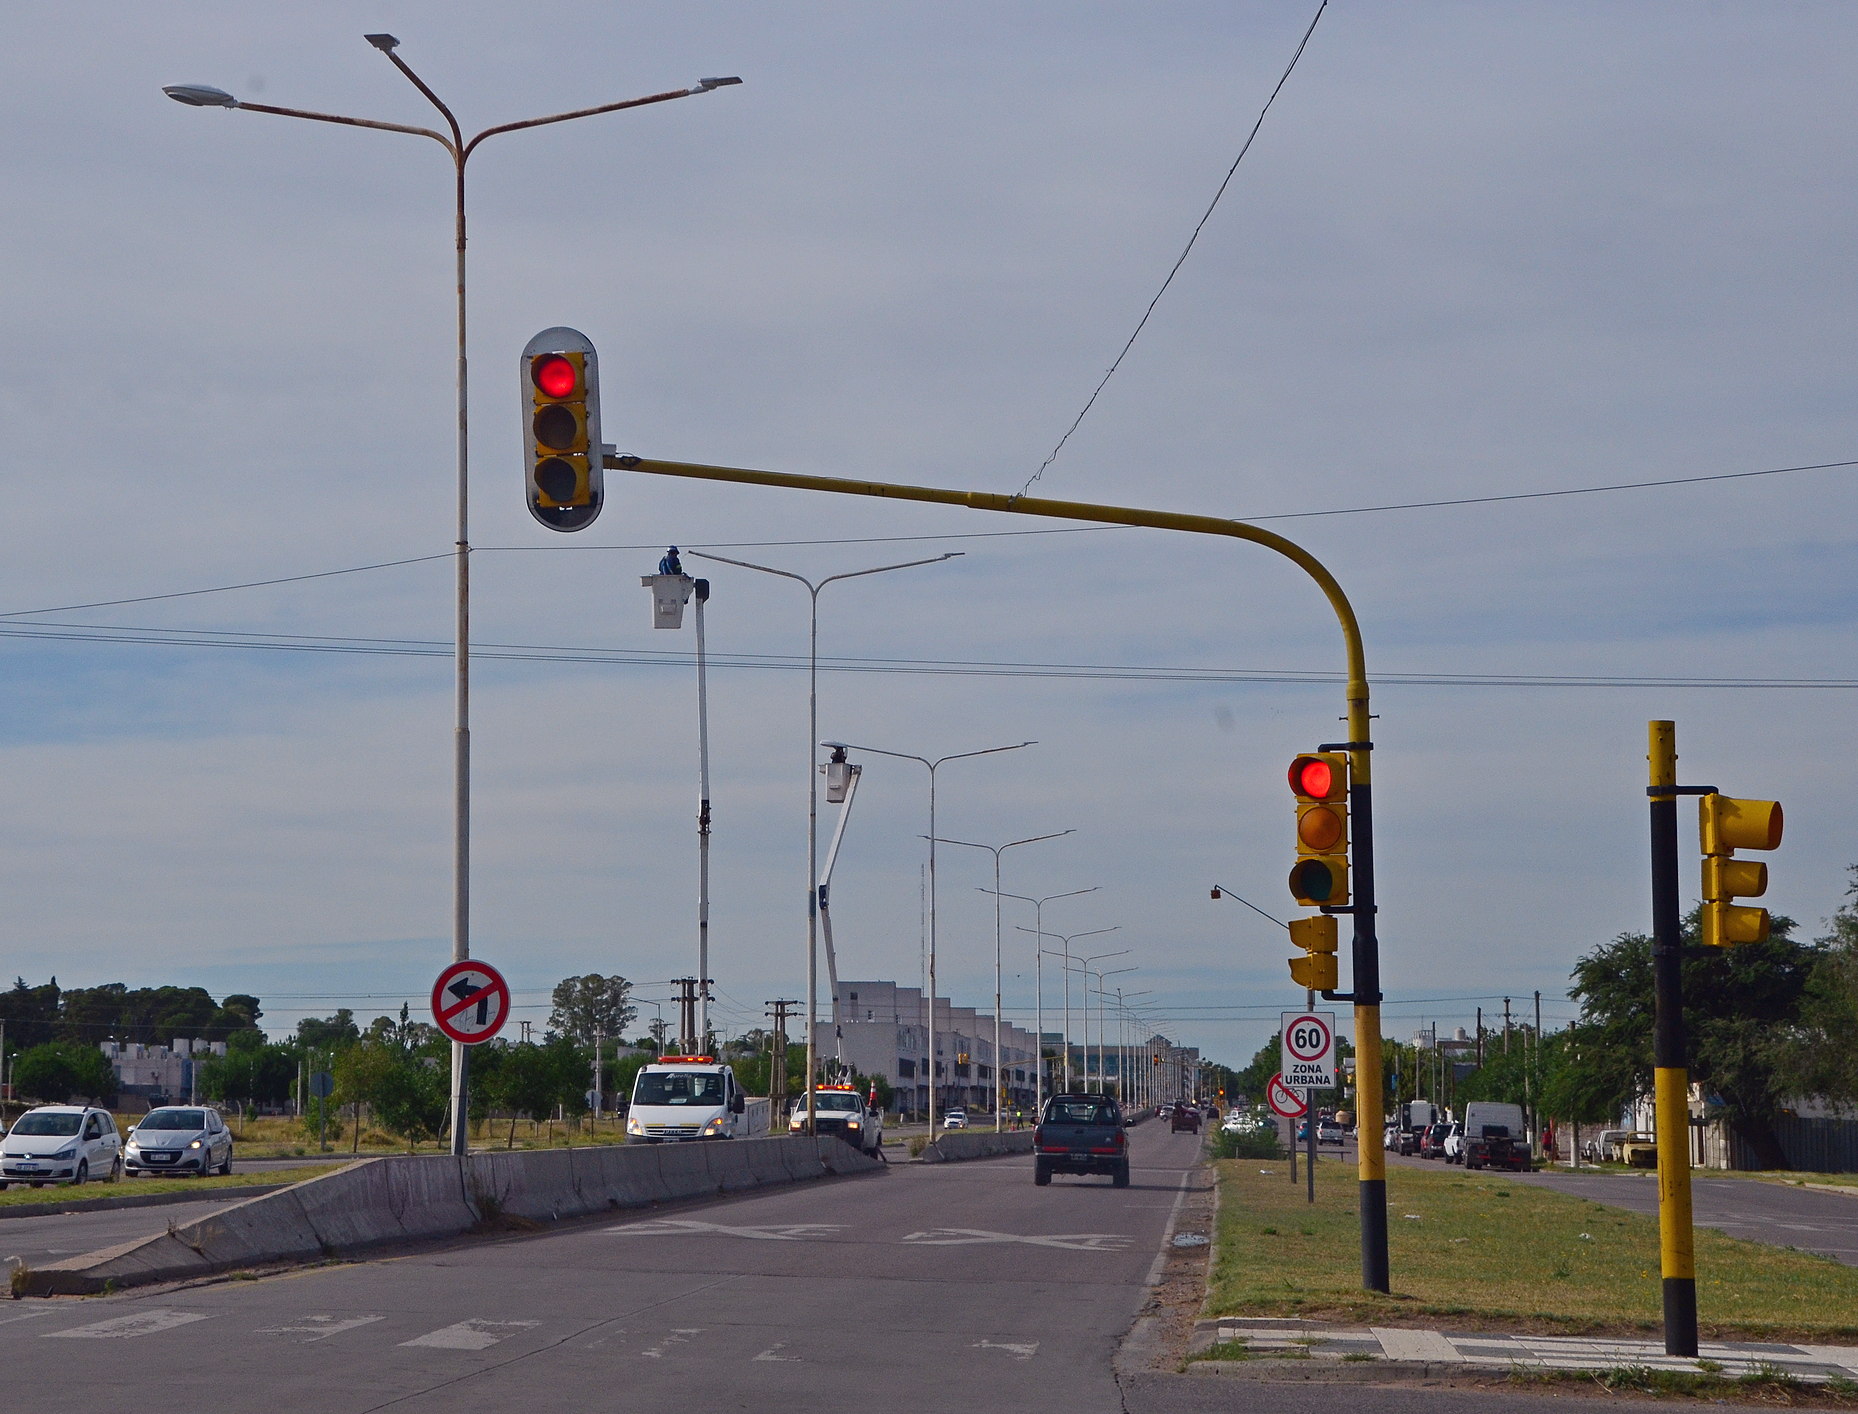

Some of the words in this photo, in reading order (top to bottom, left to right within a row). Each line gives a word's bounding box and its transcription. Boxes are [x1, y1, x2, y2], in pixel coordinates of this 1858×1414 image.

[1294, 1028, 1321, 1049] 60
[1292, 1064, 1322, 1074] ZONA
[1285, 1075, 1331, 1085] URBANA
